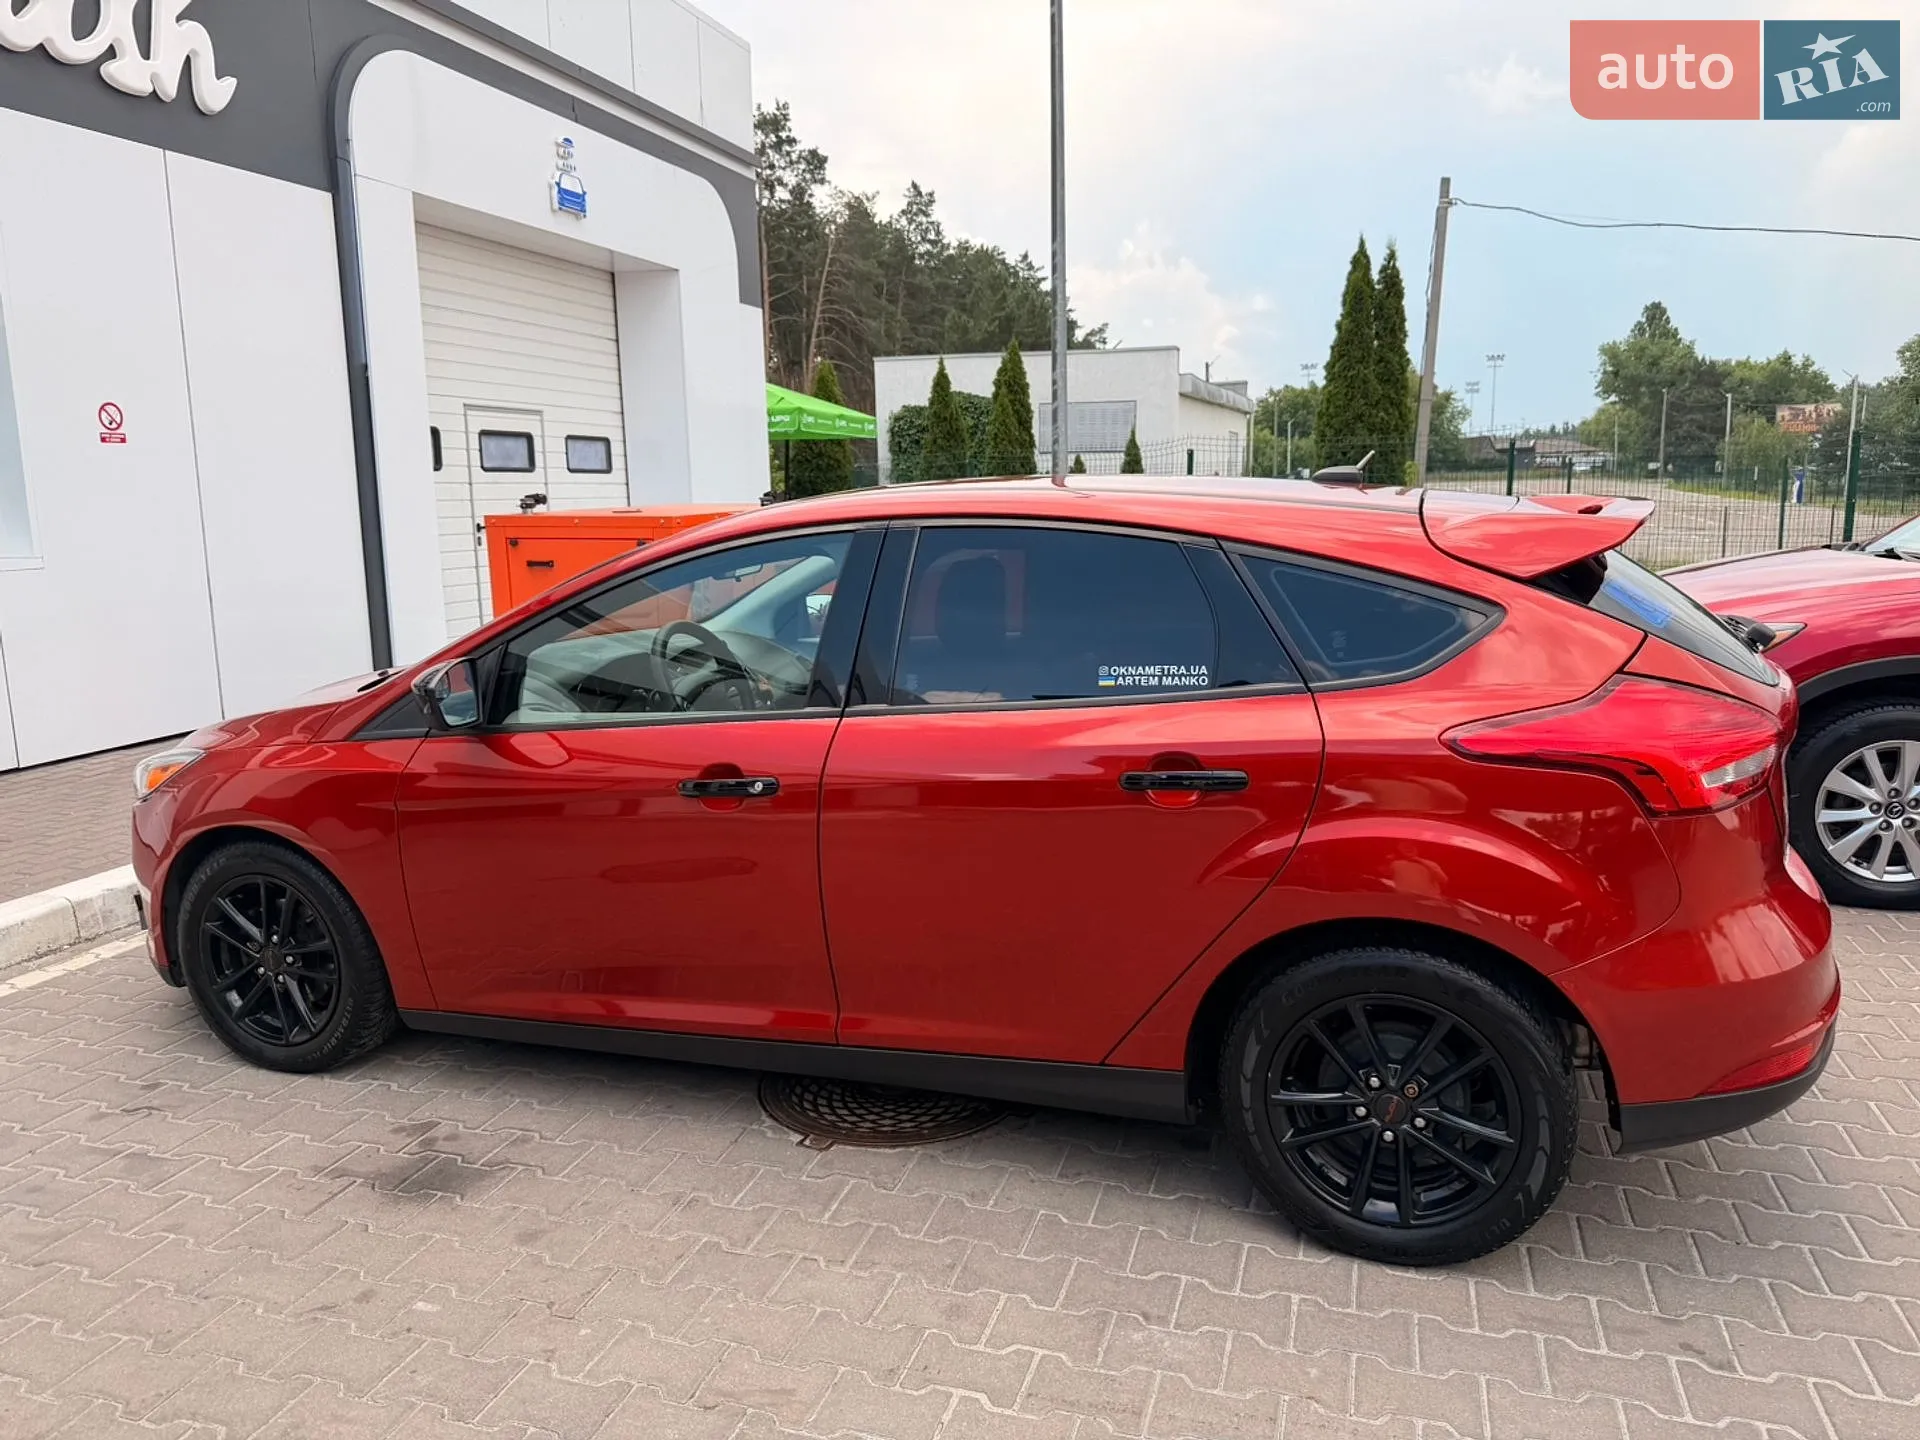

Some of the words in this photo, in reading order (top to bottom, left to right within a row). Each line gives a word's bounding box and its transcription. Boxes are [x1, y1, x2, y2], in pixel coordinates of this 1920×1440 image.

[1110, 665, 1208, 676] OKNAMETRA.UA
[1116, 676, 1159, 686] ARTEM
[1161, 676, 1208, 686] MANKO
